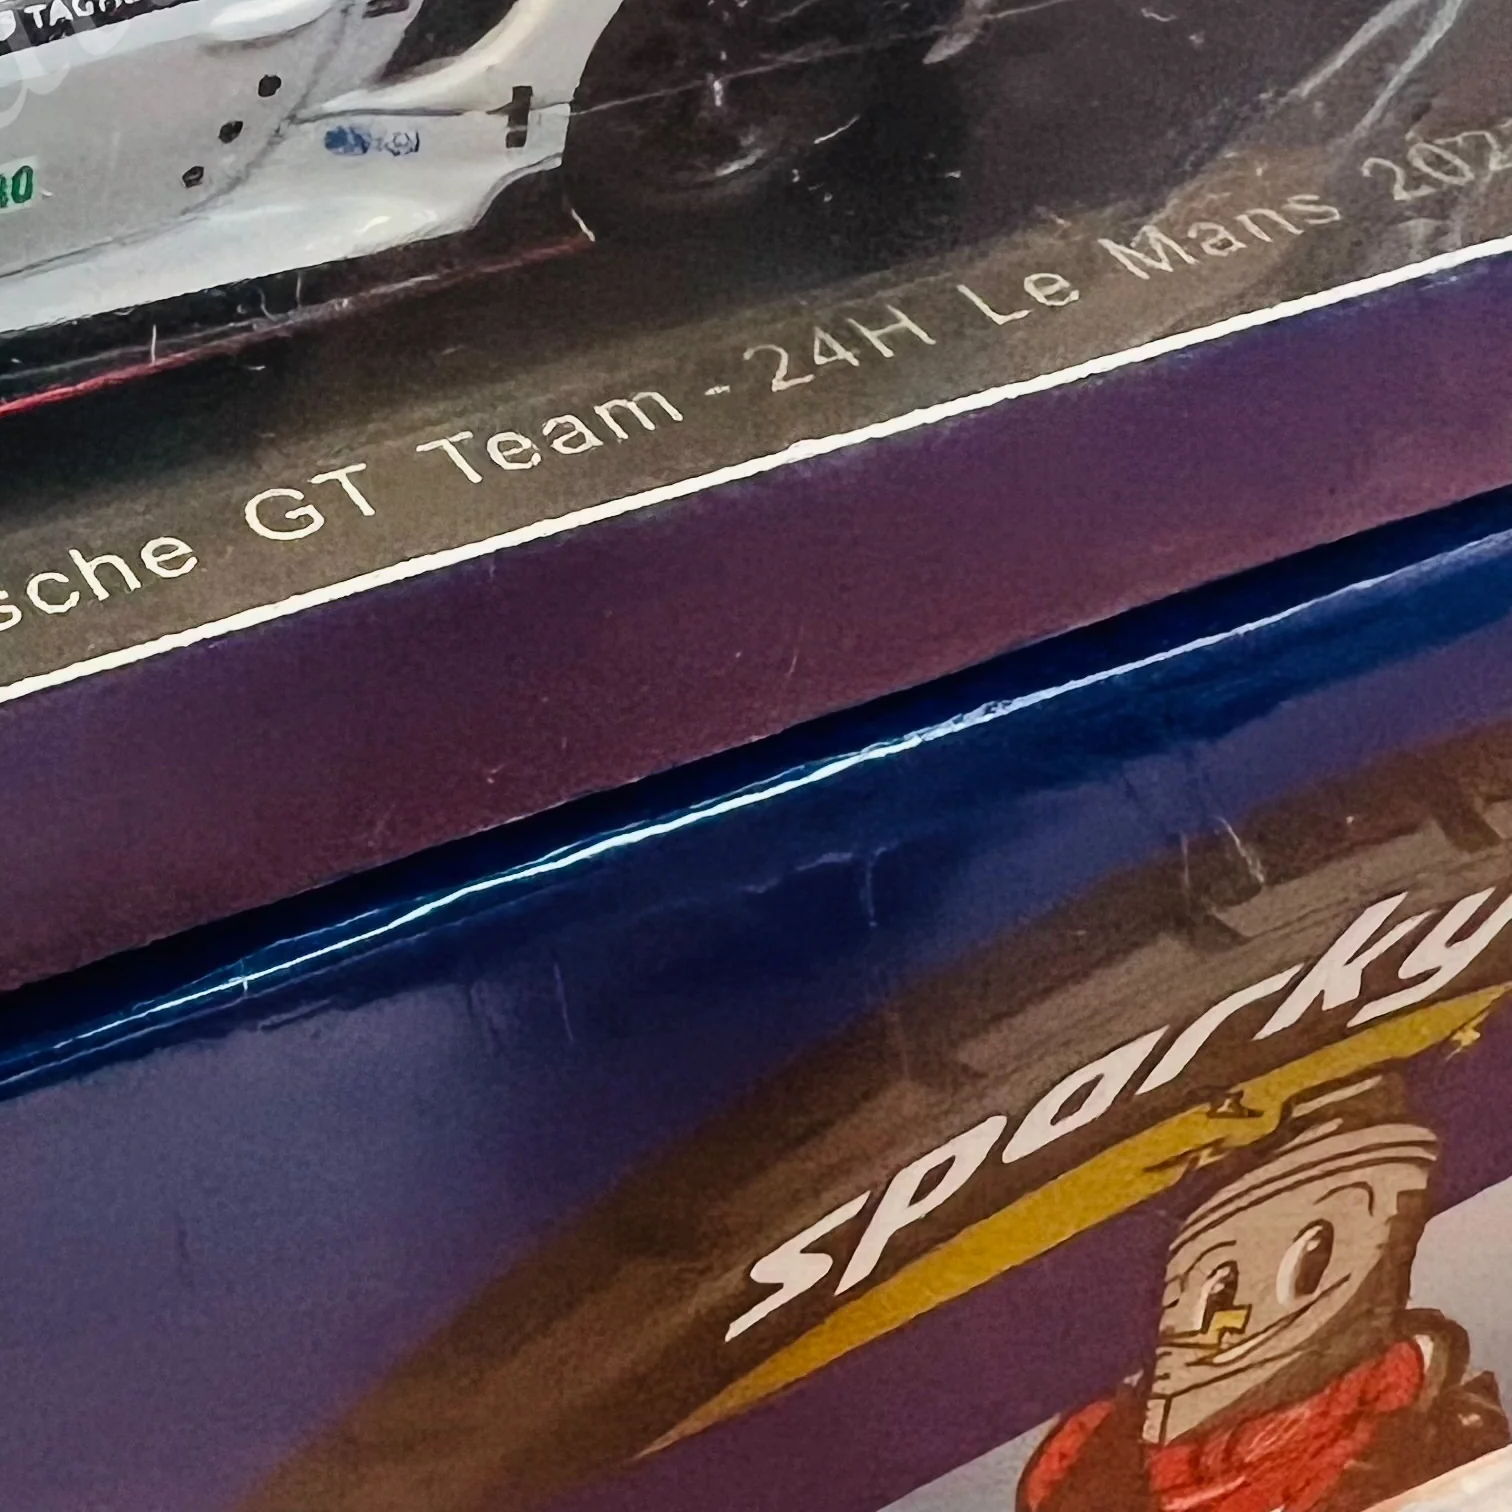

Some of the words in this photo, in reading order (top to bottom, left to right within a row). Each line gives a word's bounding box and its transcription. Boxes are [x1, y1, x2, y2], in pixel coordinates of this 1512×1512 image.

[244, 462, 376, 542] GT
[415, 391, 684, 485] Team
[743, 304, 937, 393] 24H
[956, 272, 1080, 325] Le
[1096, 194, 1342, 280] Mans
[1360, 117, 1512, 201] 202
[724, 886, 1512, 1343] sparky
